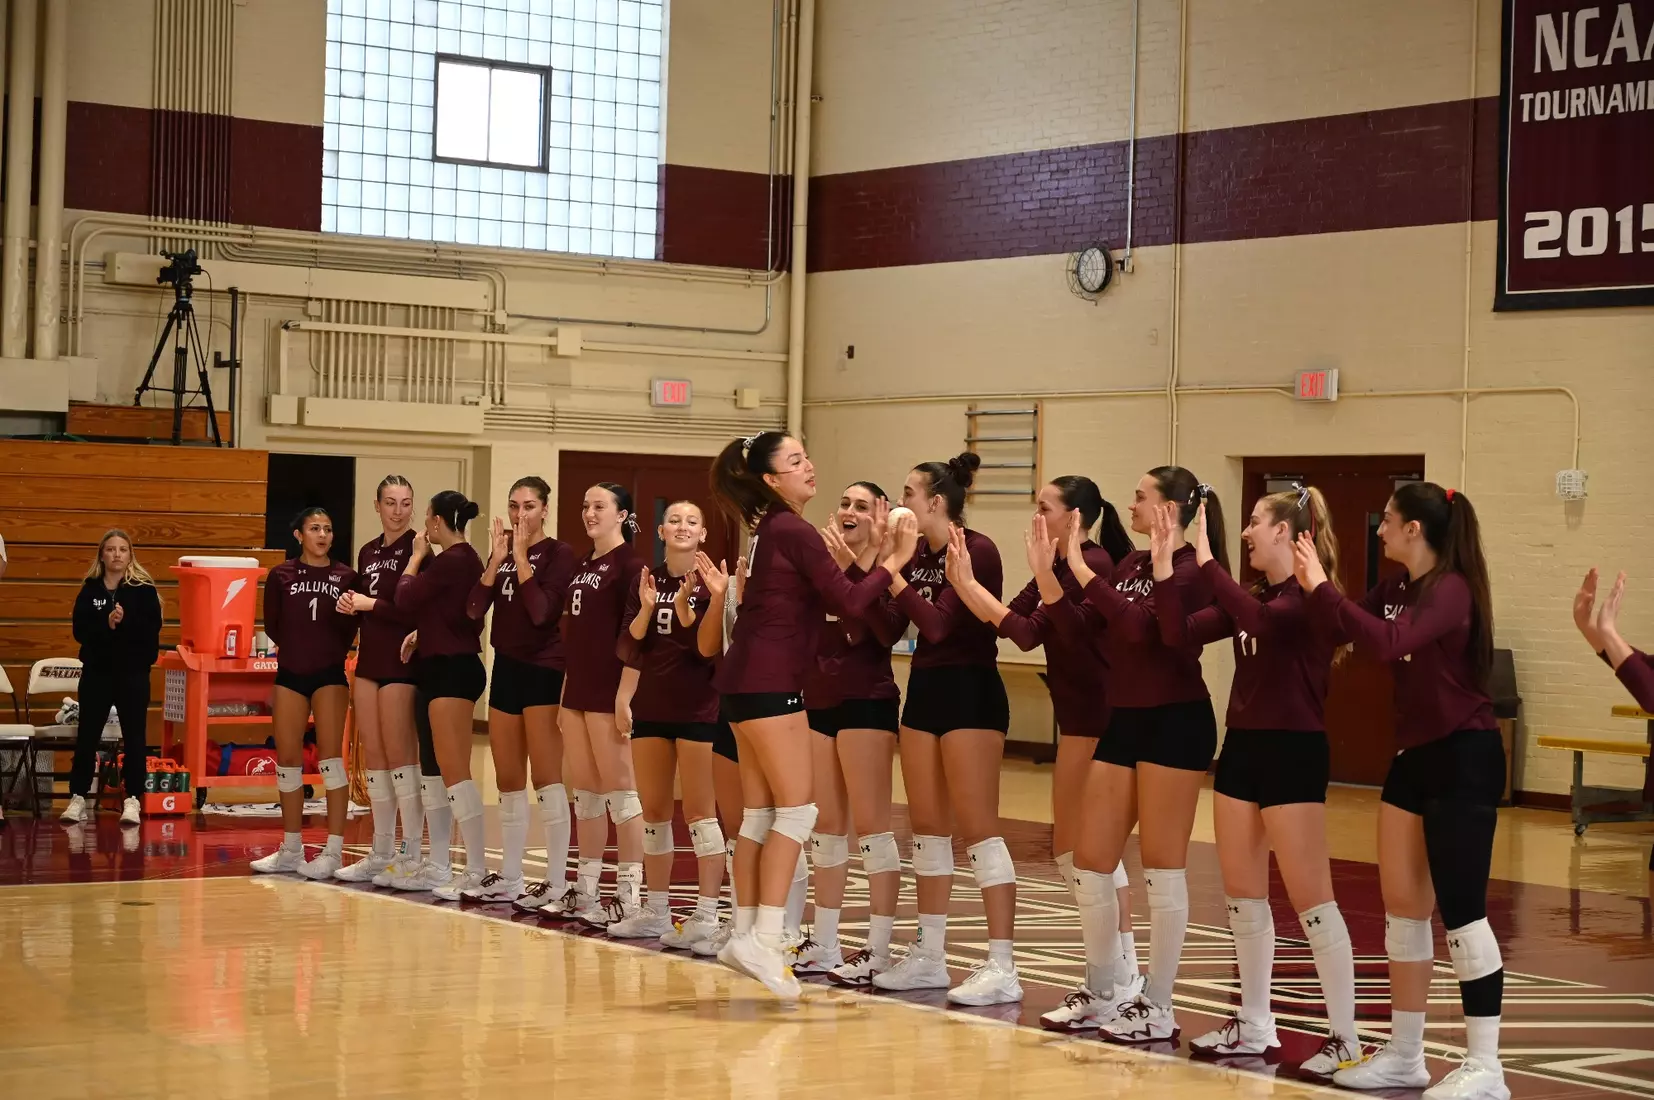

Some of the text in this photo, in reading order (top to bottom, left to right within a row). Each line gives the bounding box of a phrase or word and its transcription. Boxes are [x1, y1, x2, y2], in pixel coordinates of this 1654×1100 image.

[1534, 3, 1654, 73] NCA
[1523, 203, 1654, 259] 201
[663, 382, 687, 403] EXIT
[1301, 372, 1326, 397] EXIT
[290, 581, 340, 600] SALUKIS
[369, 572, 380, 595] 2
[501, 576, 515, 602] 4
[308, 597, 318, 621] 1
[571, 589, 582, 616] 8
[657, 608, 673, 635] 9
[145, 779, 154, 789] G
[160, 779, 170, 789] G
[162, 796, 175, 811] G
